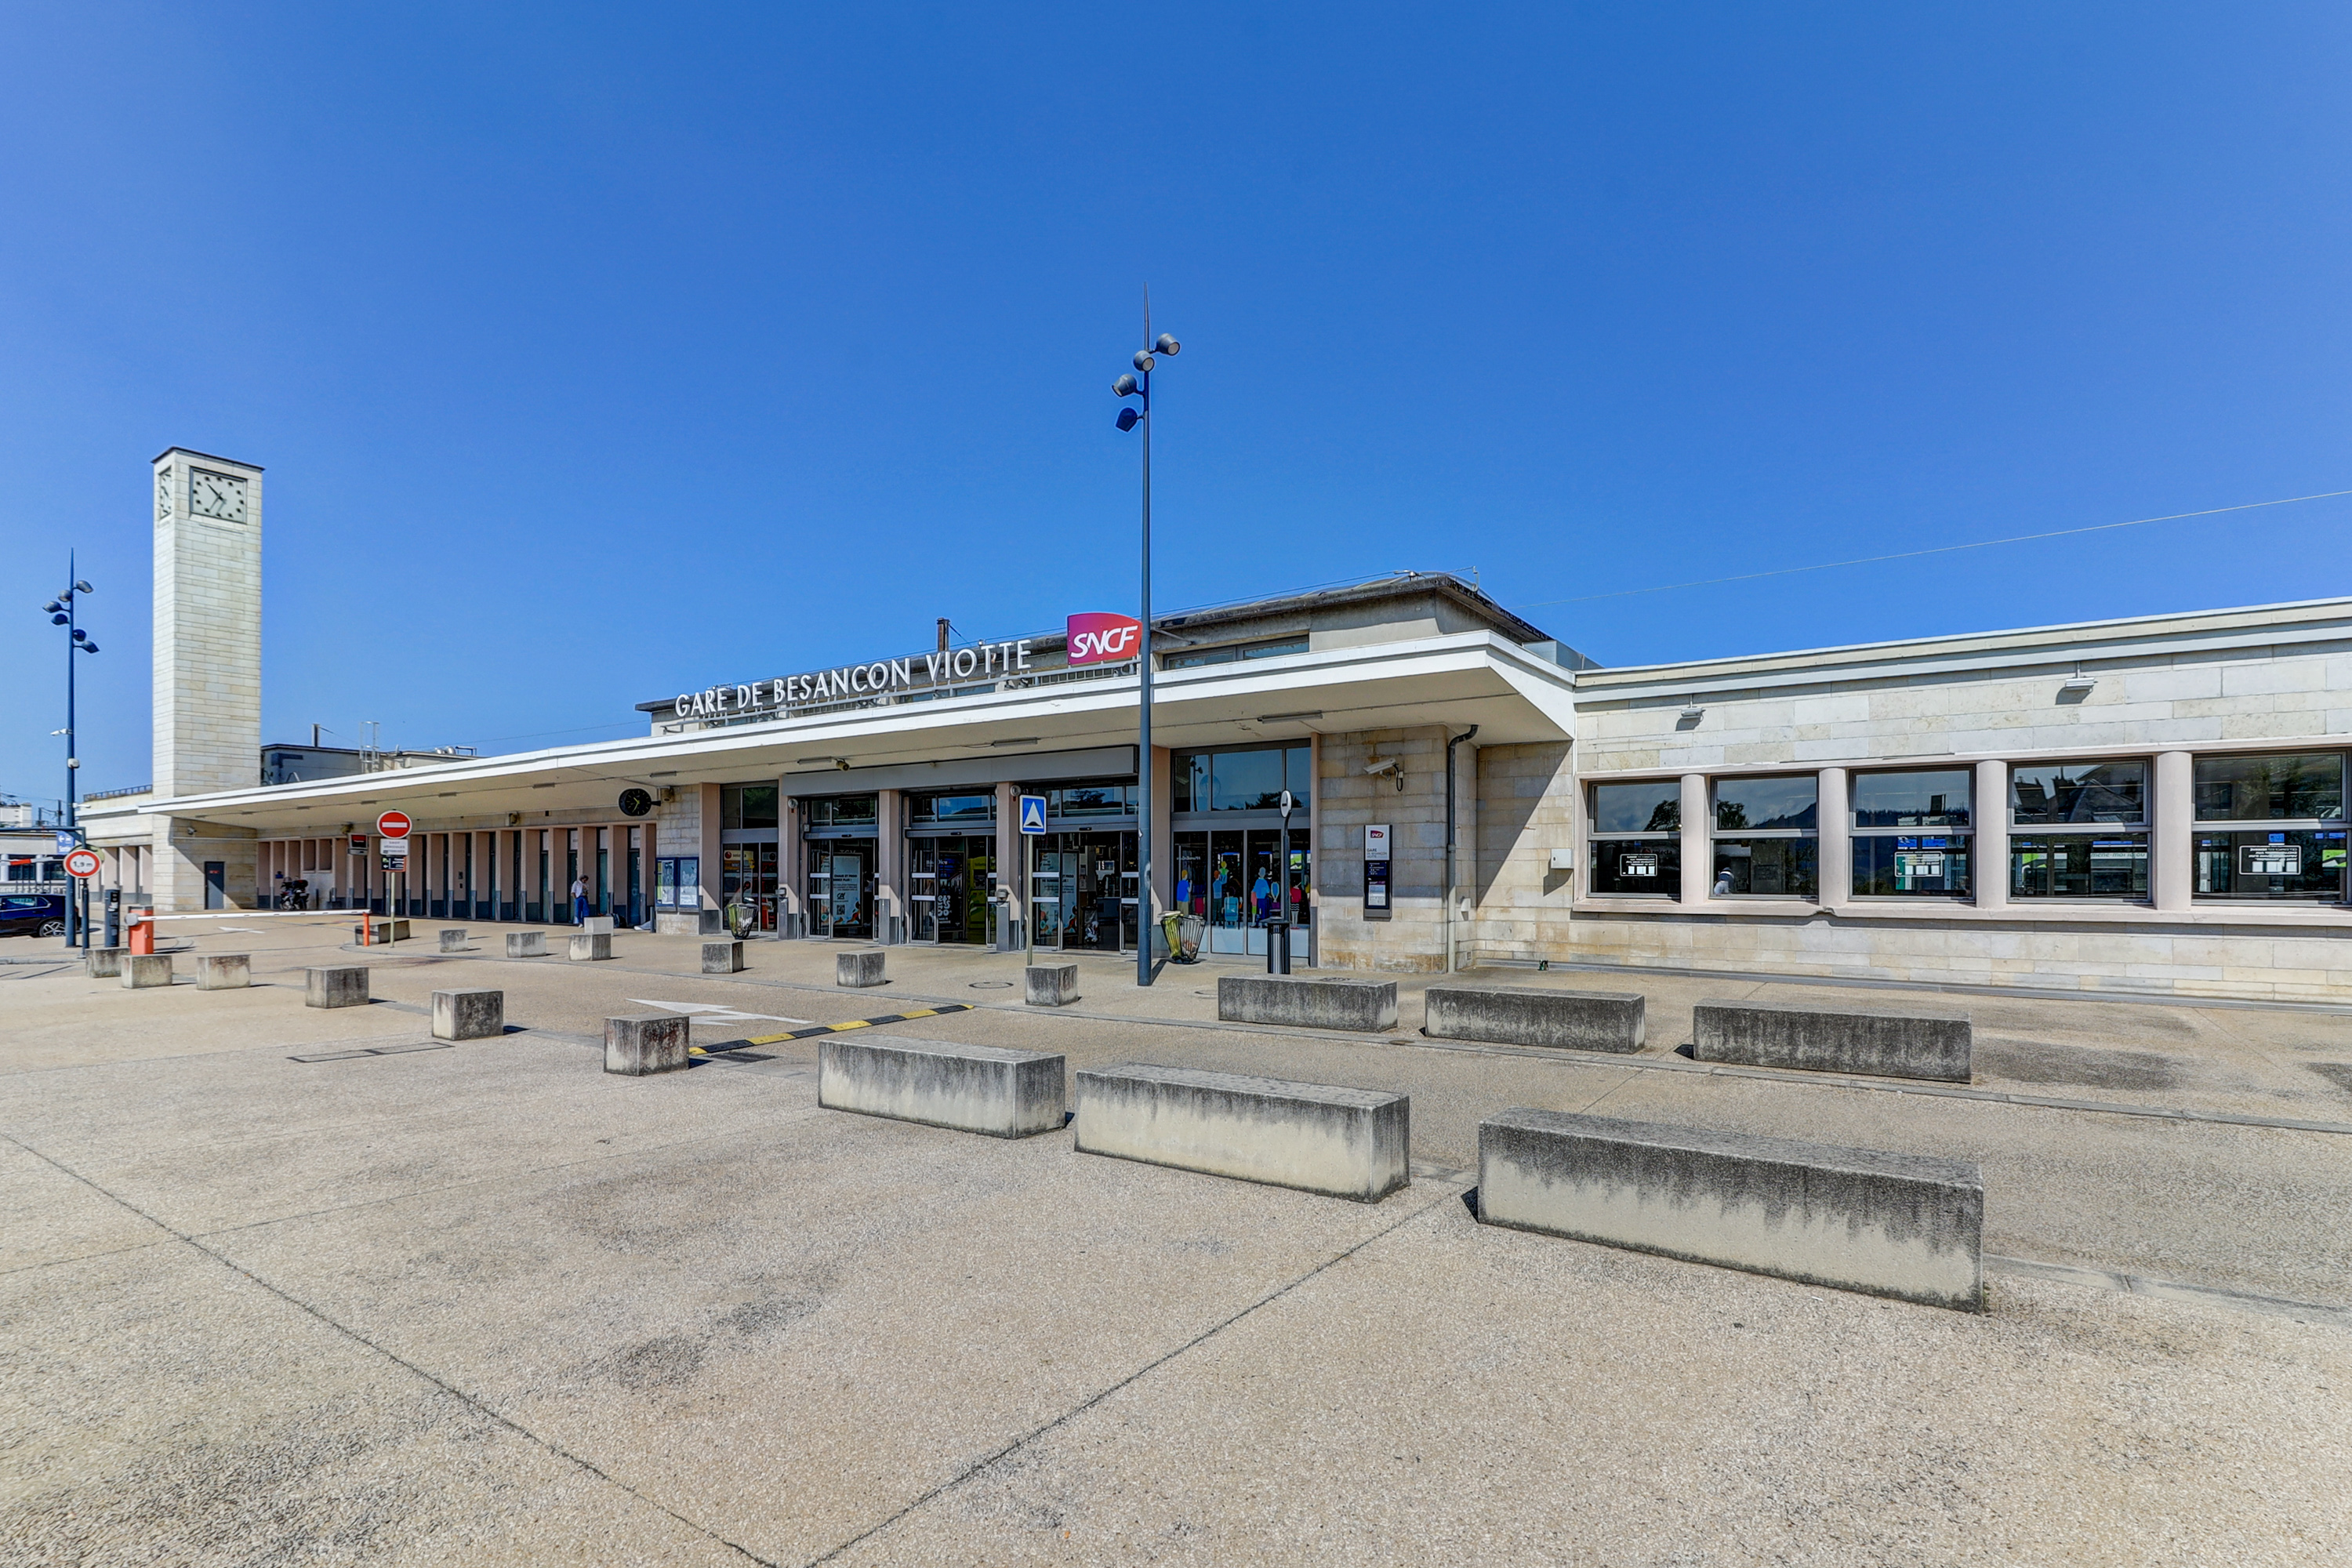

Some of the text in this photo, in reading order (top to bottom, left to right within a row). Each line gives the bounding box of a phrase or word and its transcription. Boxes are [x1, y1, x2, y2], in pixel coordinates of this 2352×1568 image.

[1069, 625, 1138, 659] SNCF
[675, 688, 728, 717] GARE
[737, 682, 764, 709] DE
[925, 639, 1033, 682] VIOTTE
